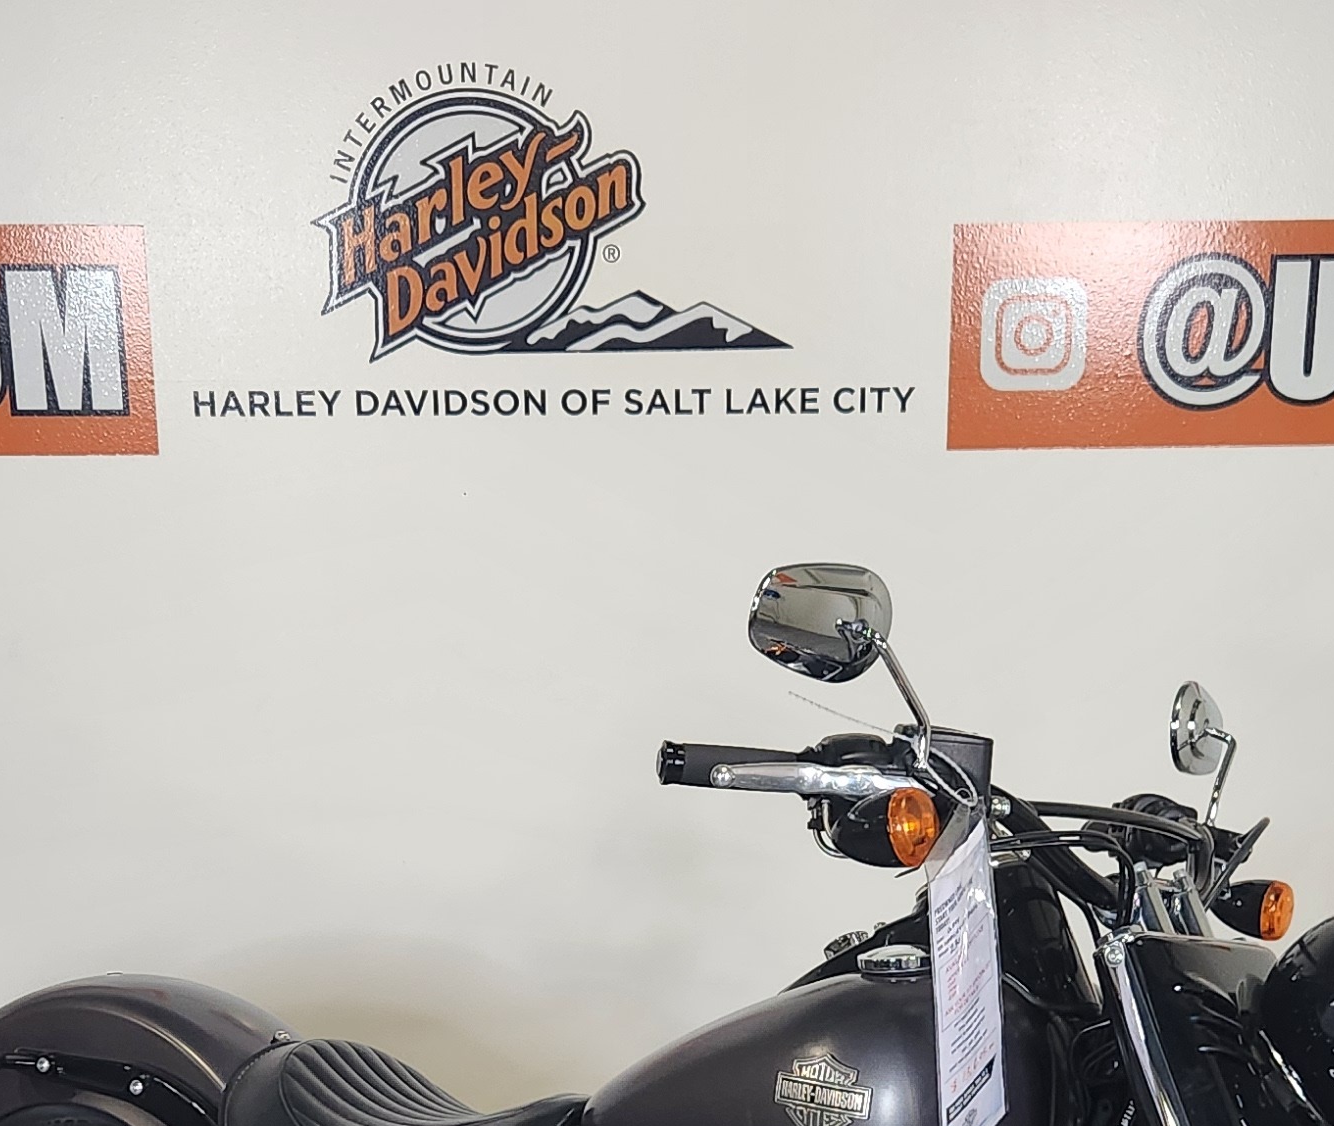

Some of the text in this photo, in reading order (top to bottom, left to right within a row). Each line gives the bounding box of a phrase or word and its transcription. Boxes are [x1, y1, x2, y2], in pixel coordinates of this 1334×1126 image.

[329, 61, 554, 185] INTERMOUNTAIN
[337, 131, 579, 286] Harley-
[386, 161, 632, 338] Davidson
[193, 386, 915, 417] HARLEY DAVIDSON OF SALT LAKE CITY
[781, 1079, 864, 1112] HARLEY-DAVIDSON
